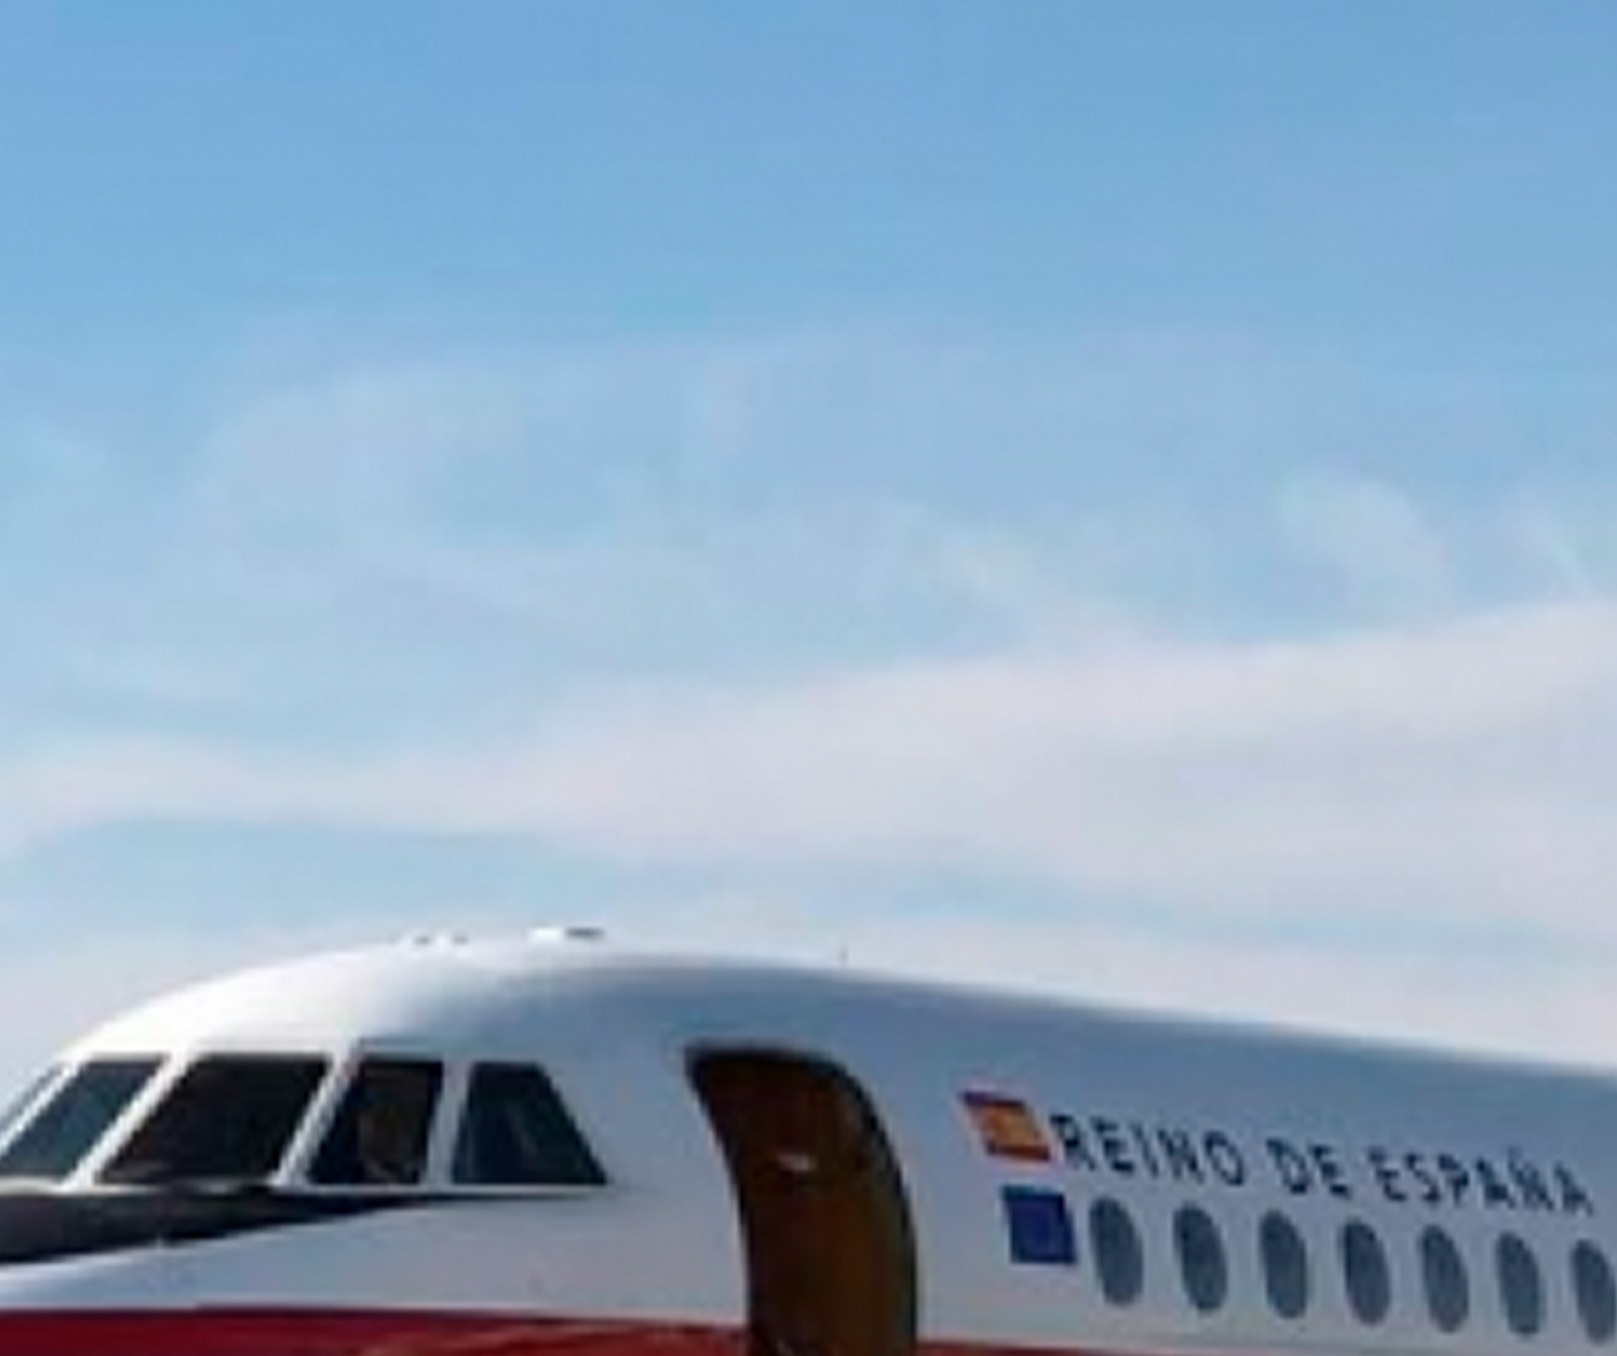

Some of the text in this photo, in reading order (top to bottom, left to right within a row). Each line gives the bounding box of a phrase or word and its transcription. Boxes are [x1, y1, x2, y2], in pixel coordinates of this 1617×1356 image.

[1049, 1112, 1595, 1216] REINO DE ESPAÑA
